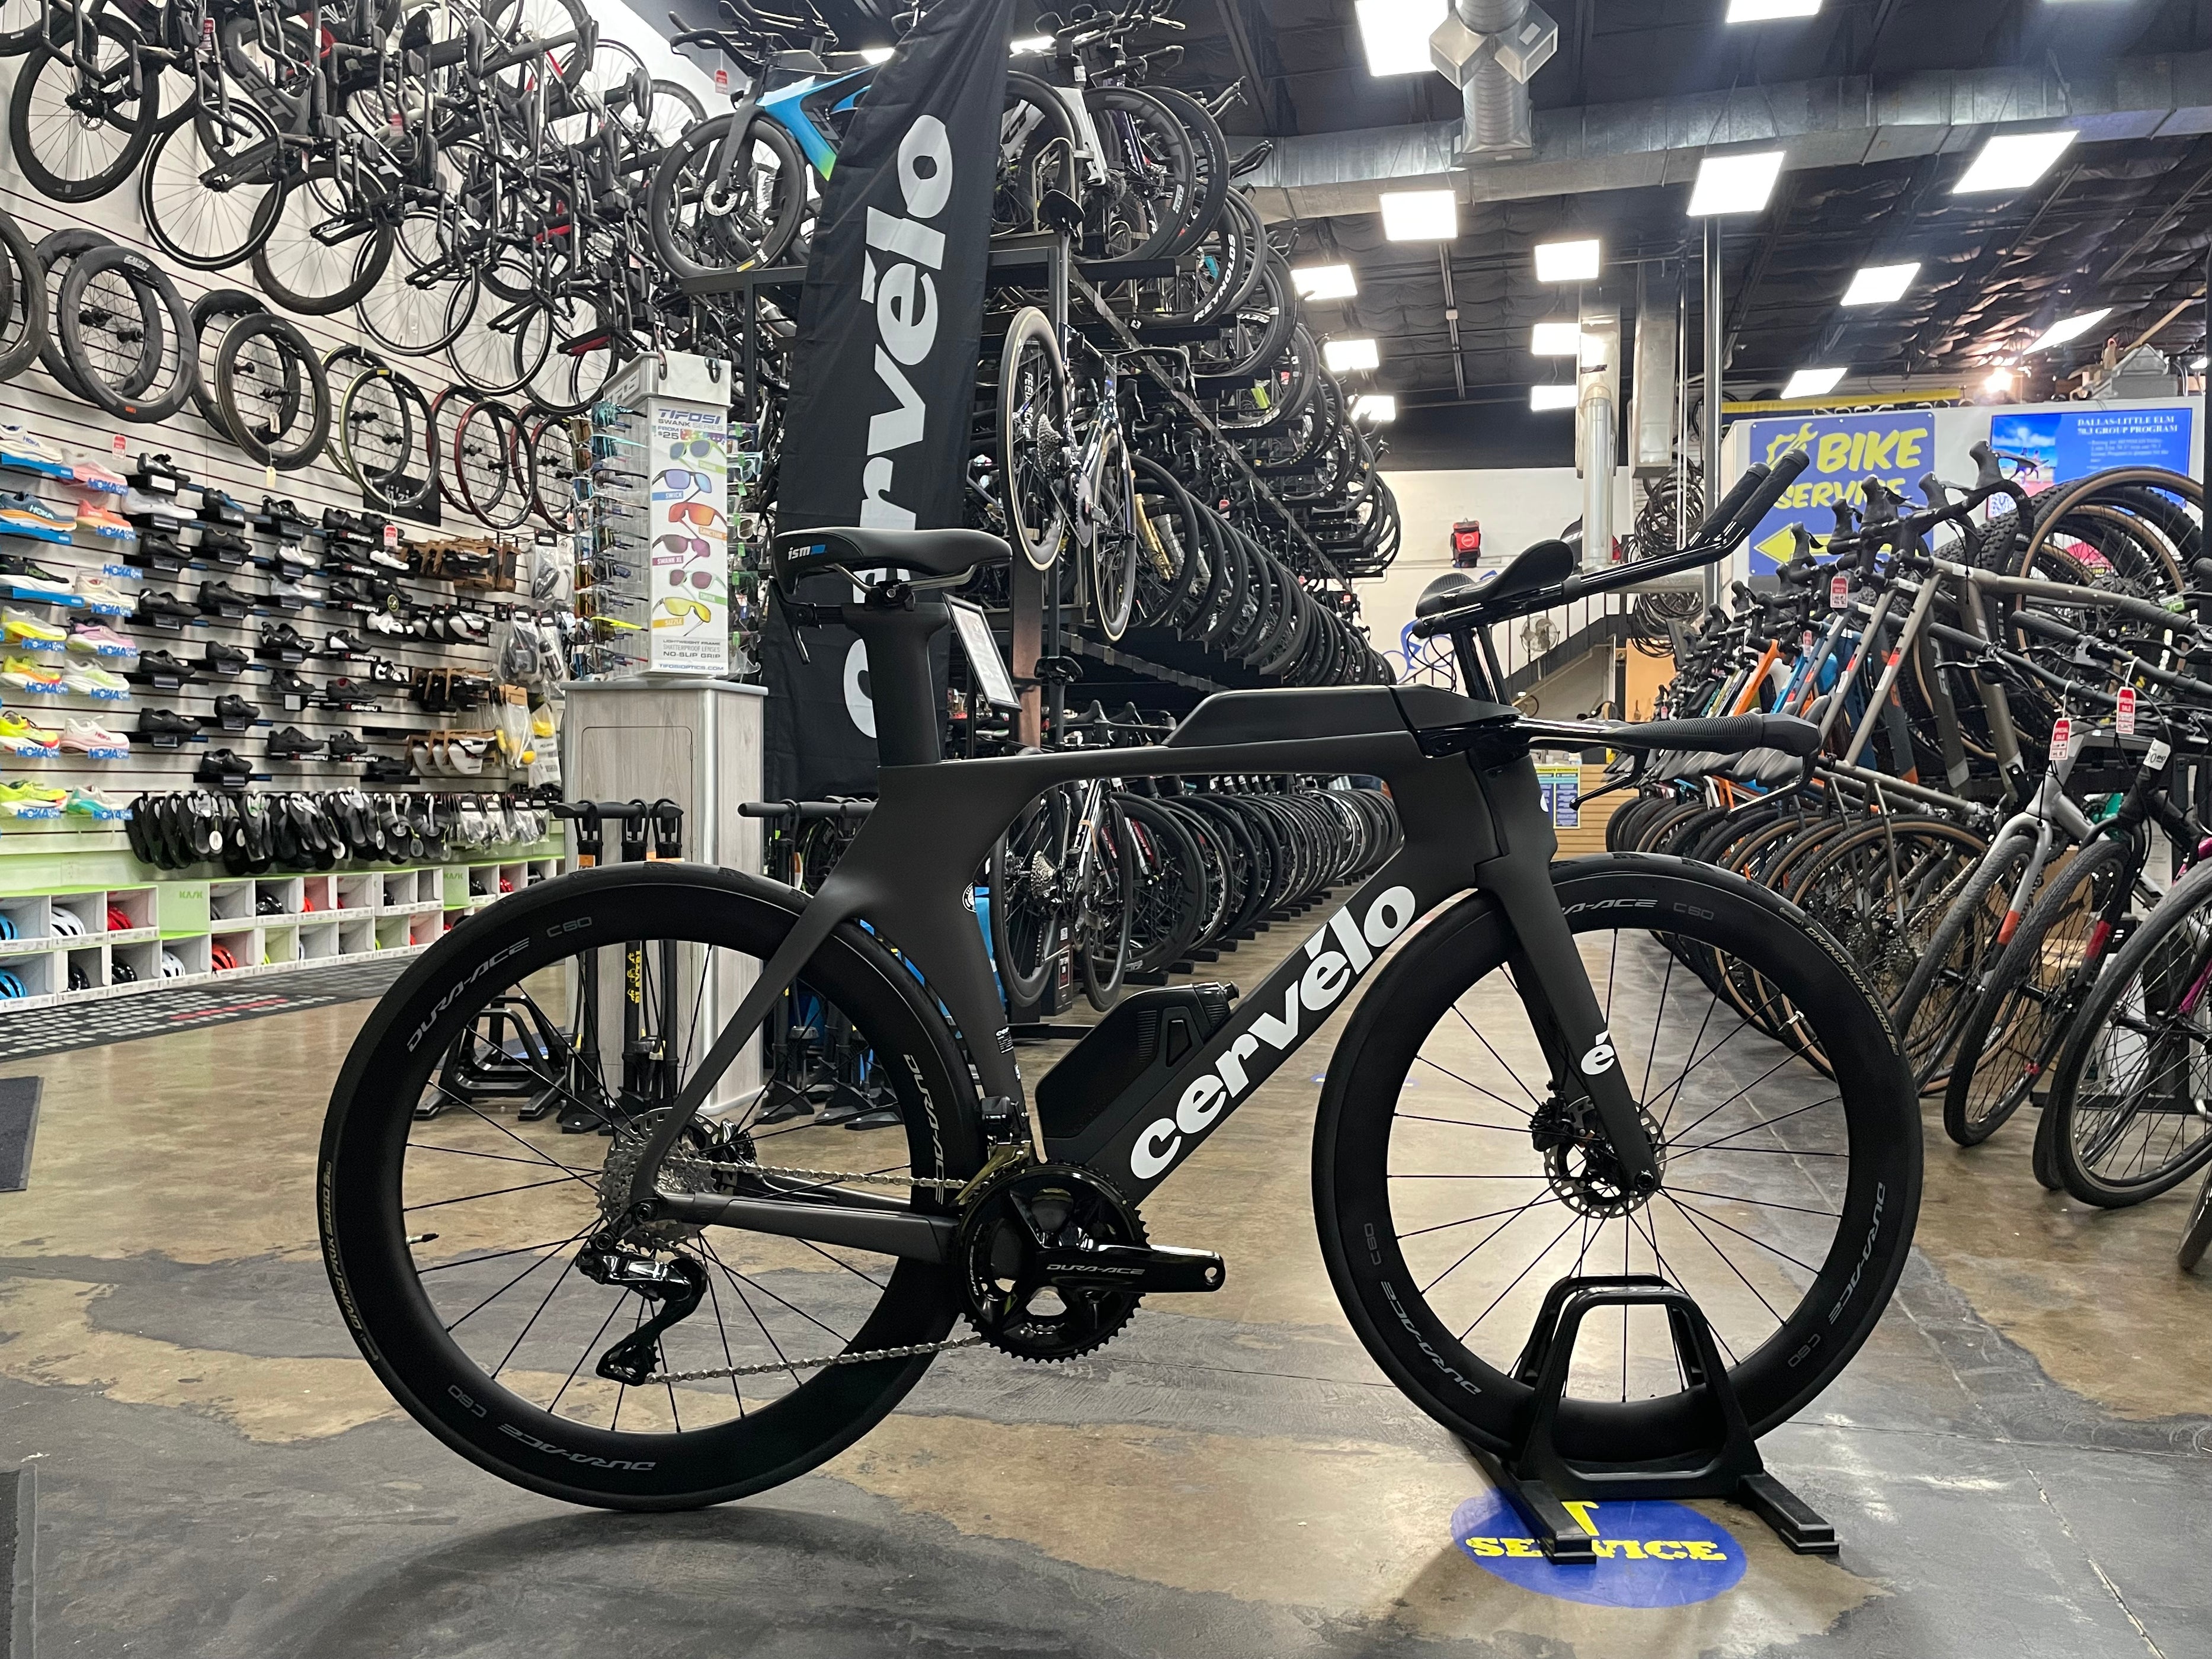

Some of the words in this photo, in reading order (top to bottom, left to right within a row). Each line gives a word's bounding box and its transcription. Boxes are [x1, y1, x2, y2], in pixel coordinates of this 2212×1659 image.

[237, 71, 296, 118] ELT
[1193, 233, 1237, 324] REYNOLDS
[658, 408, 721, 424] TIFOSI
[658, 418, 692, 428] SWANK
[692, 422, 724, 431] SERIES
[2077, 416, 2152, 427] DALLAS-LITTLE
[2153, 415, 2175, 424] ELM
[2095, 425, 2128, 435] GROUP
[2130, 424, 2178, 434] PROGRAM
[1816, 427, 1928, 473] BIKE
[88, 478, 117, 492] HOKA
[30, 504, 54, 520] HOKA
[98, 525, 126, 540] HOKA
[788, 545, 811, 561] ism
[103, 563, 131, 578] HOKA
[92, 603, 121, 615] HOKA
[98, 645, 126, 657] HOKA
[25, 682, 56, 694] HOKA
[91, 688, 119, 700] HOKA
[17, 747, 49, 758] HOKA
[88, 748, 119, 759] HOKA
[17, 808, 49, 819] HOKA
[179, 891, 203, 899] KASK
[1561, 898, 1659, 915] A-ACE
[1673, 902, 1715, 921] C60
[406, 936, 530, 1053] DURA-ACE
[546, 915, 593, 938] C60
[1804, 926, 1845, 965] GRAND
[1842, 962, 1868, 994] PRIX
[1865, 994, 1893, 1035] 5000
[1131, 886, 1416, 1179] cervélo
[1580, 1030, 1617, 1075] é
[323, 1187, 334, 1236] 5000
[1364, 1223, 1382, 1266] C60
[1828, 1181, 1886, 1325] DURA-ACE
[326, 1235, 342, 1276] PRIX
[1046, 1263, 1145, 1276] DURA-ACE
[335, 1276, 363, 1331] GRAND
[1381, 1280, 1483, 1395] DURA-ACE
[1787, 1333, 1822, 1368] C60
[448, 1384, 488, 1419] C60
[497, 1423, 657, 1472] DURA-ACE
[1465, 1537, 1728, 1561] SEVICE
